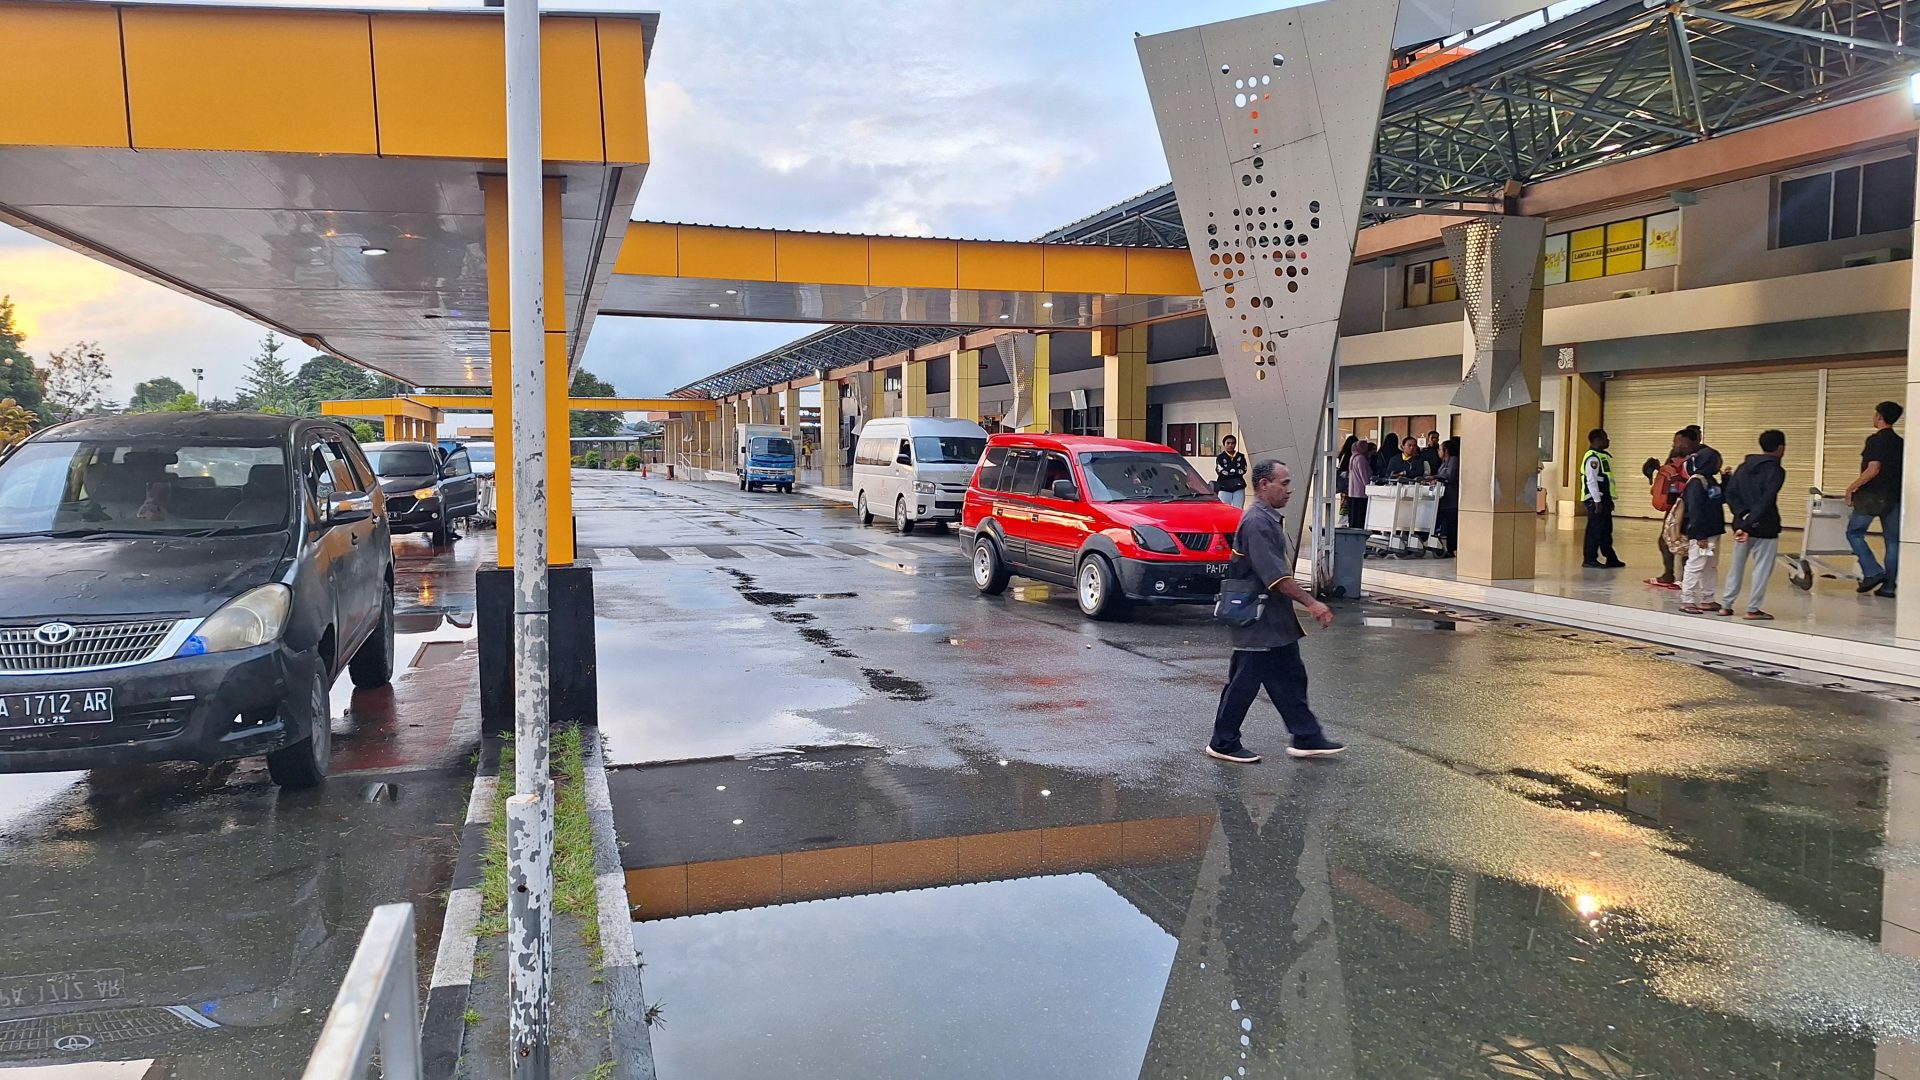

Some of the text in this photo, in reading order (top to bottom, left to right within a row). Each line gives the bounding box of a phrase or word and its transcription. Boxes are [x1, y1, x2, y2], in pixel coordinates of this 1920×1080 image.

[1574, 251, 1590, 260] LANTAI
[0, 691, 108, 717] A 1712 AR
